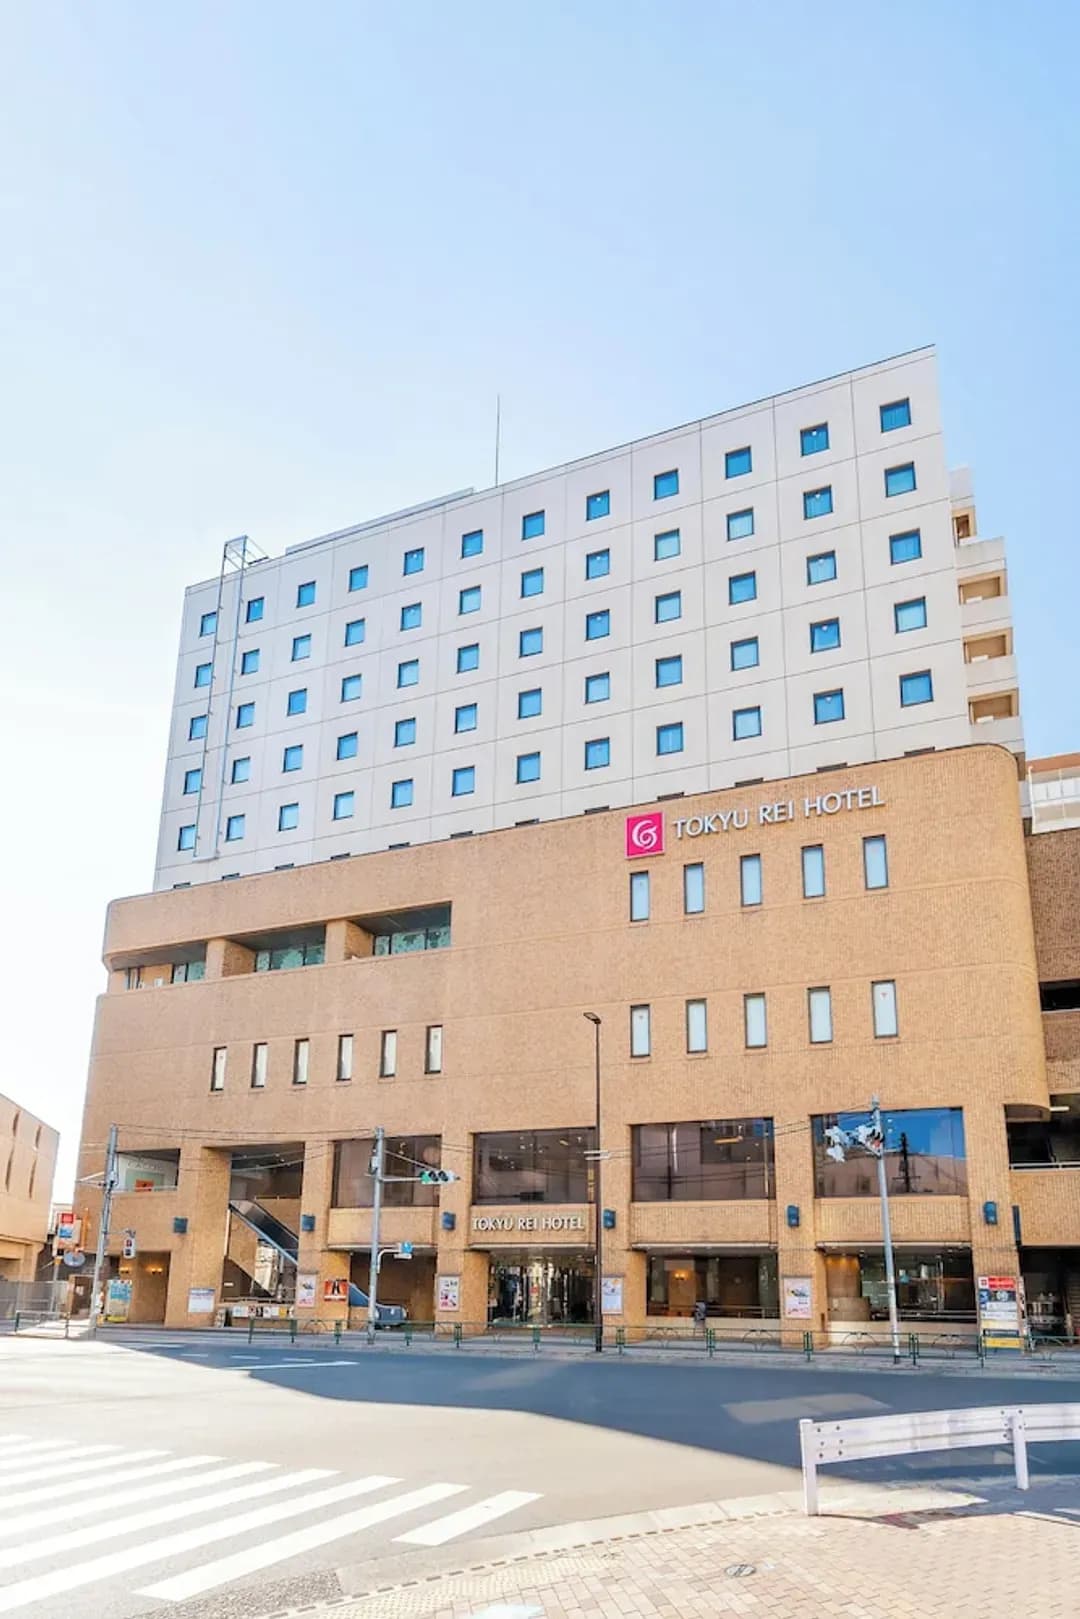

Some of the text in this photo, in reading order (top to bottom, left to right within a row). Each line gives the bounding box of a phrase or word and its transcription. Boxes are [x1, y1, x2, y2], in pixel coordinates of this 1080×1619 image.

[674, 786, 885, 839] TOKYU REI HOTEL
[473, 1216, 585, 1231] TOKYU REI HOTEL
